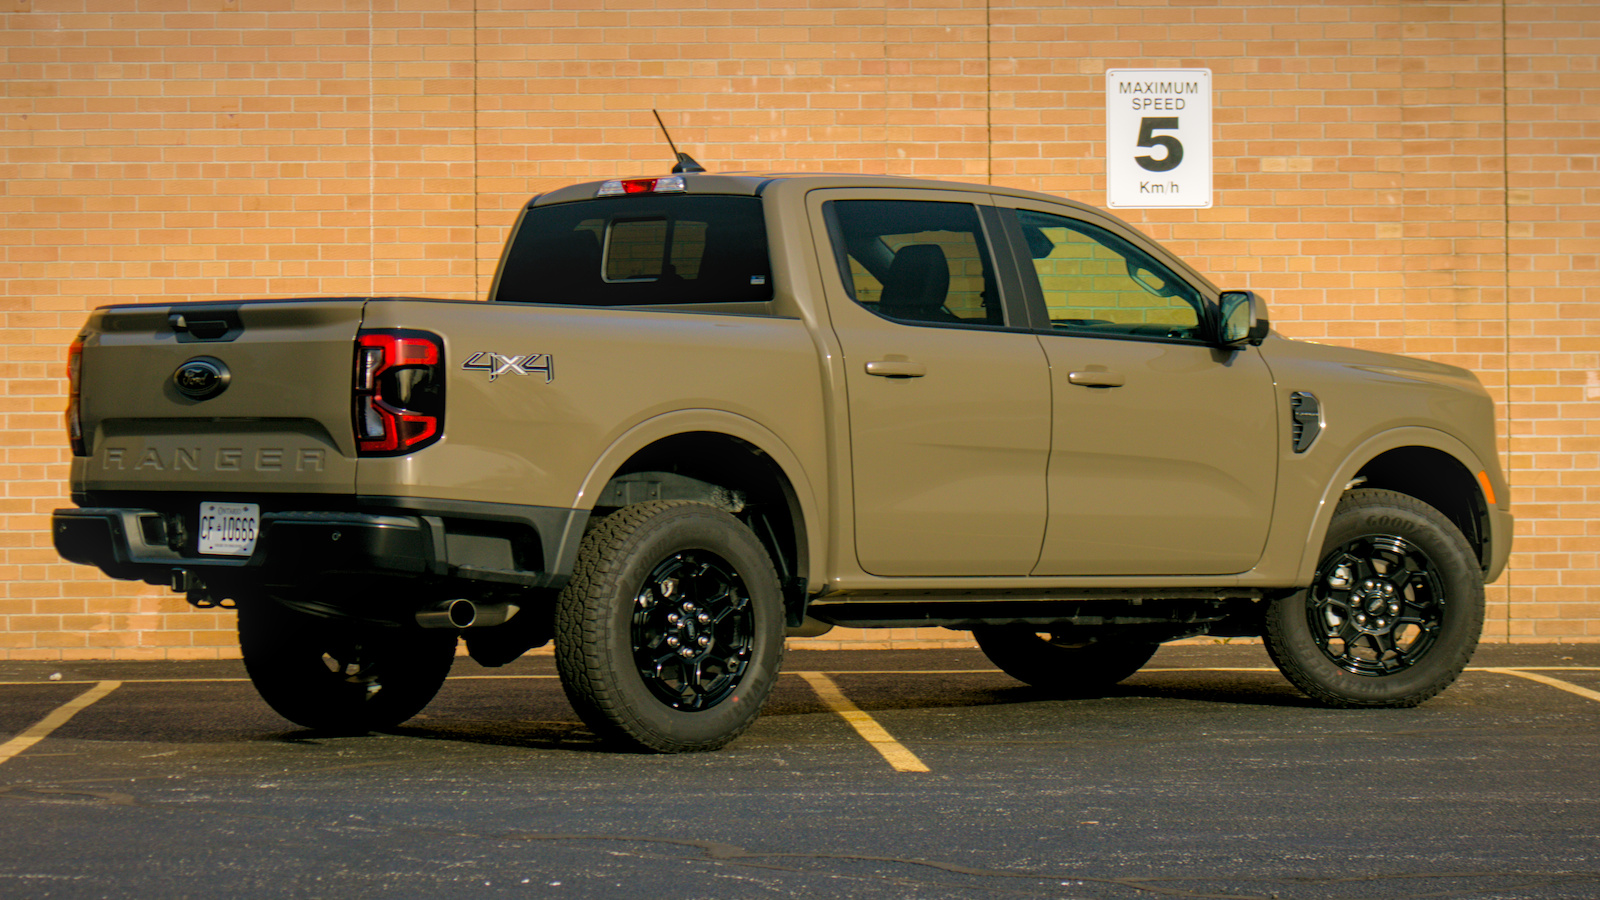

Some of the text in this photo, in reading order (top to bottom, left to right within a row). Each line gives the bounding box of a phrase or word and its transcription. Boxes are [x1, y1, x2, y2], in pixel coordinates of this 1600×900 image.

[1119, 82, 1198, 94] MAXIMUM
[1132, 98, 1186, 110] SPEED
[1134, 116, 1184, 173] 5
[1139, 181, 1180, 195] Km/h
[102, 447, 326, 472] RANGER
